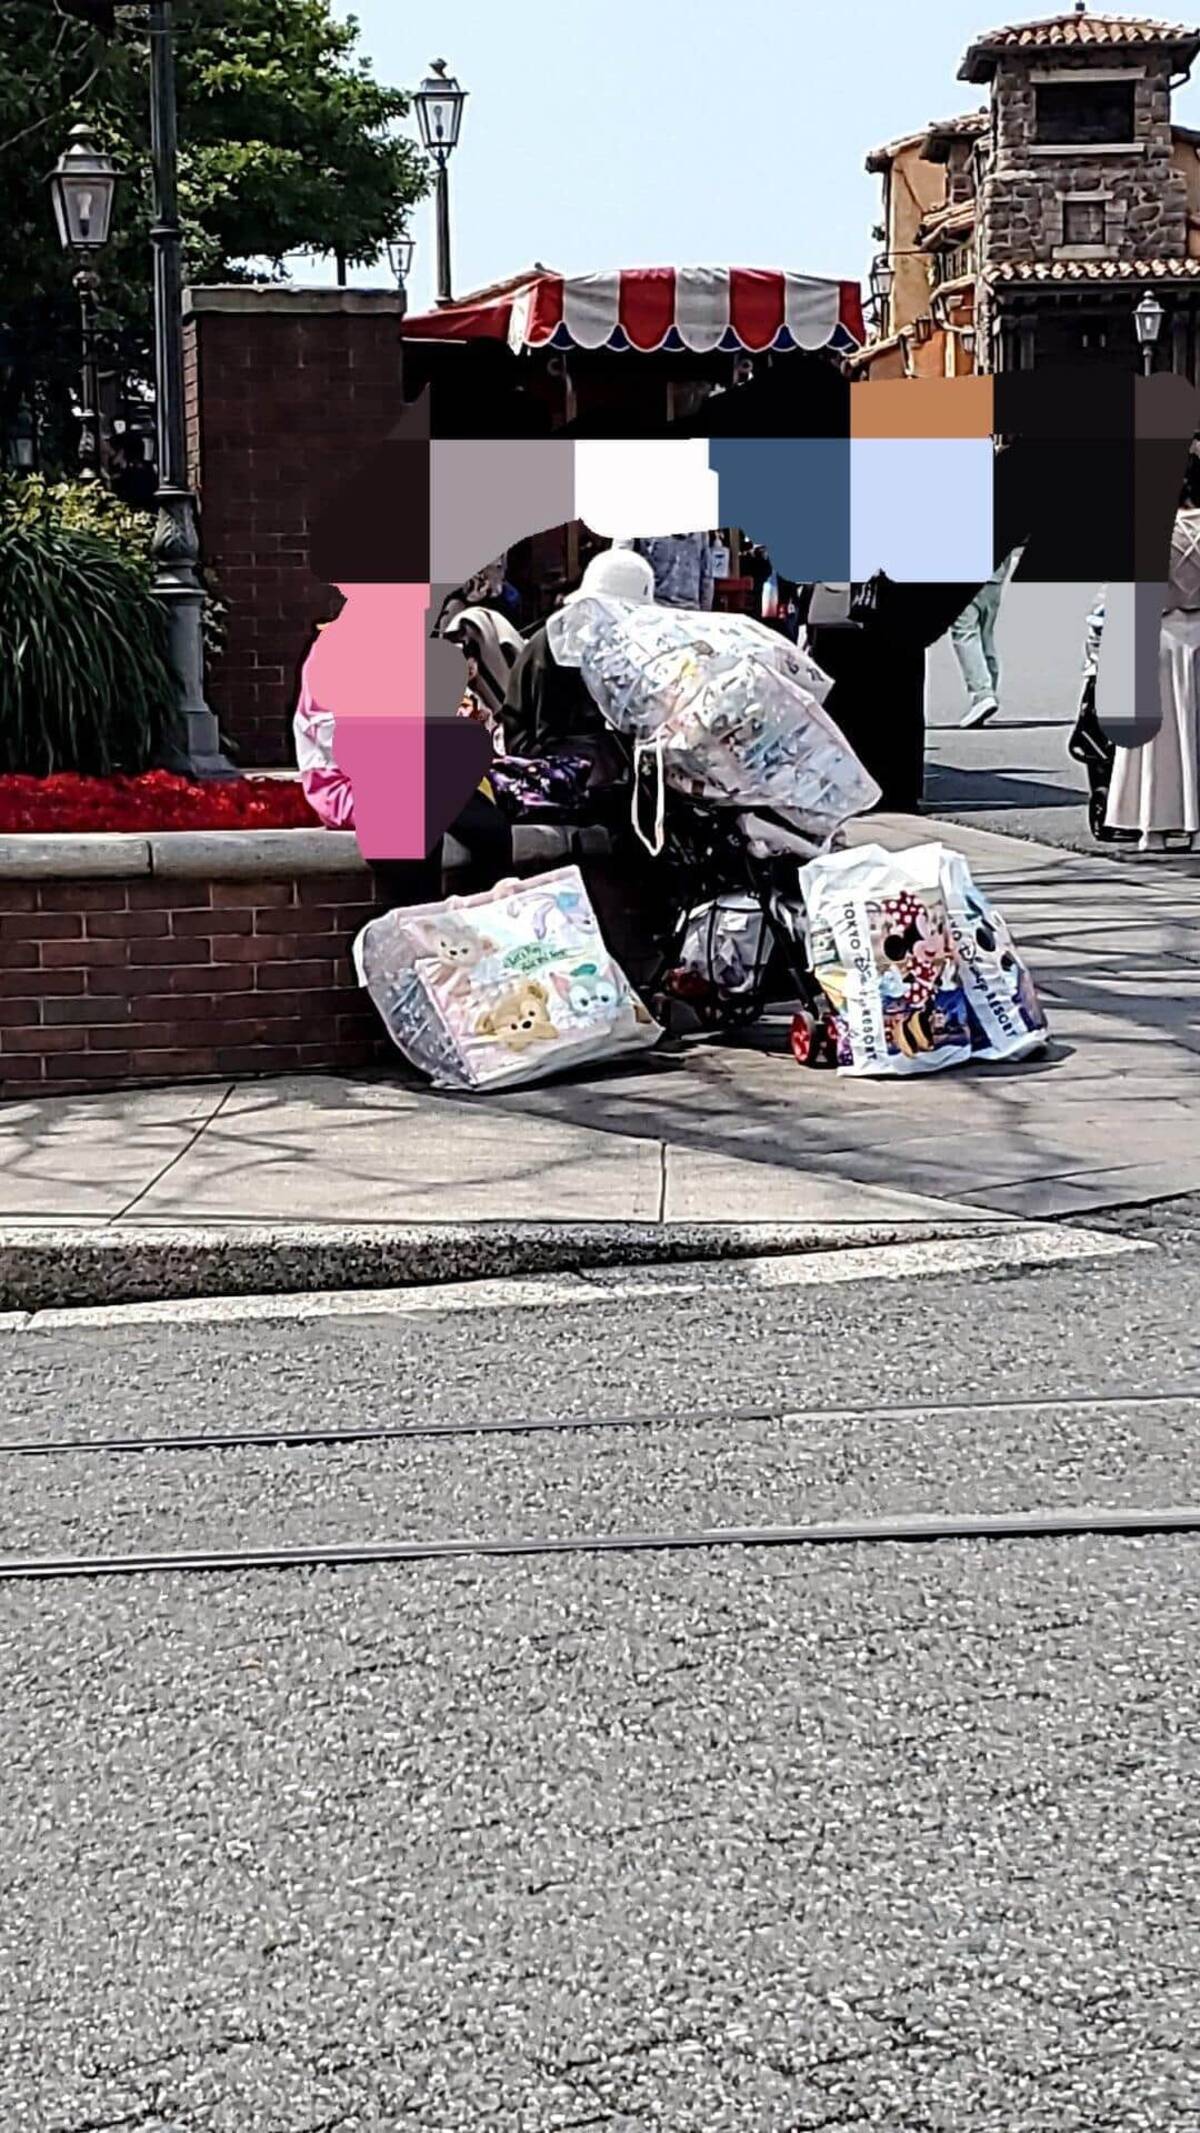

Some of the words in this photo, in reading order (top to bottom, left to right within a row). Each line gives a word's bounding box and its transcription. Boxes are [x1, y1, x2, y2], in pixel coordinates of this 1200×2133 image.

[843, 901, 861, 949] TOKYO
[861, 1010, 877, 1060] RESORT
[986, 992, 1018, 1037] RESORT
